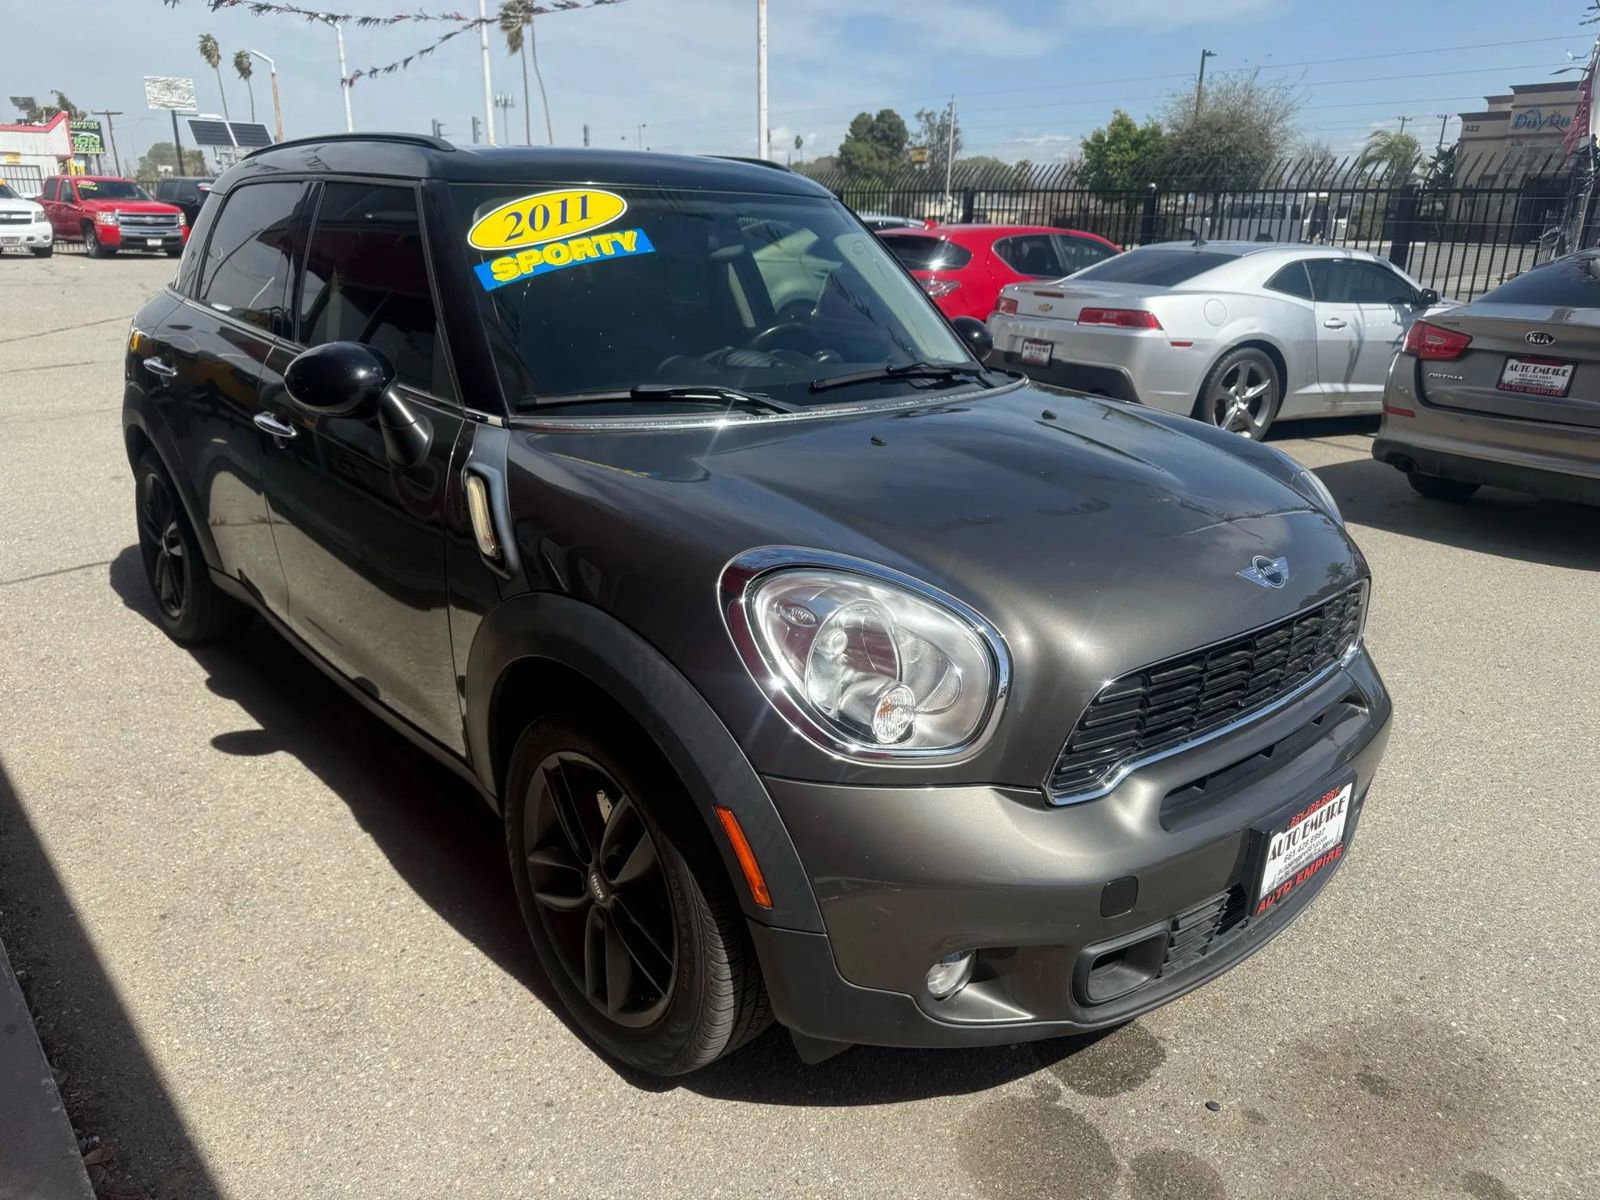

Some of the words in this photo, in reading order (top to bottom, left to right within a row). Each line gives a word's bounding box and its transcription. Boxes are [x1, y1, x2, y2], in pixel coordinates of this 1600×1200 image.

[503, 194, 592, 243] 2011
[490, 230, 638, 282] SPORTY
[1528, 333, 1550, 344] KIA
[1508, 364, 1531, 374] AUTO
[1532, 366, 1569, 377] EMPIRE
[1260, 565, 1280, 576] MINI
[1268, 827, 1301, 863] AUTO
[1302, 796, 1346, 839] EMPIRE
[591, 874, 604, 899] MINI
[1255, 879, 1292, 916] AUTO
[1296, 844, 1344, 886] EMPIRE
